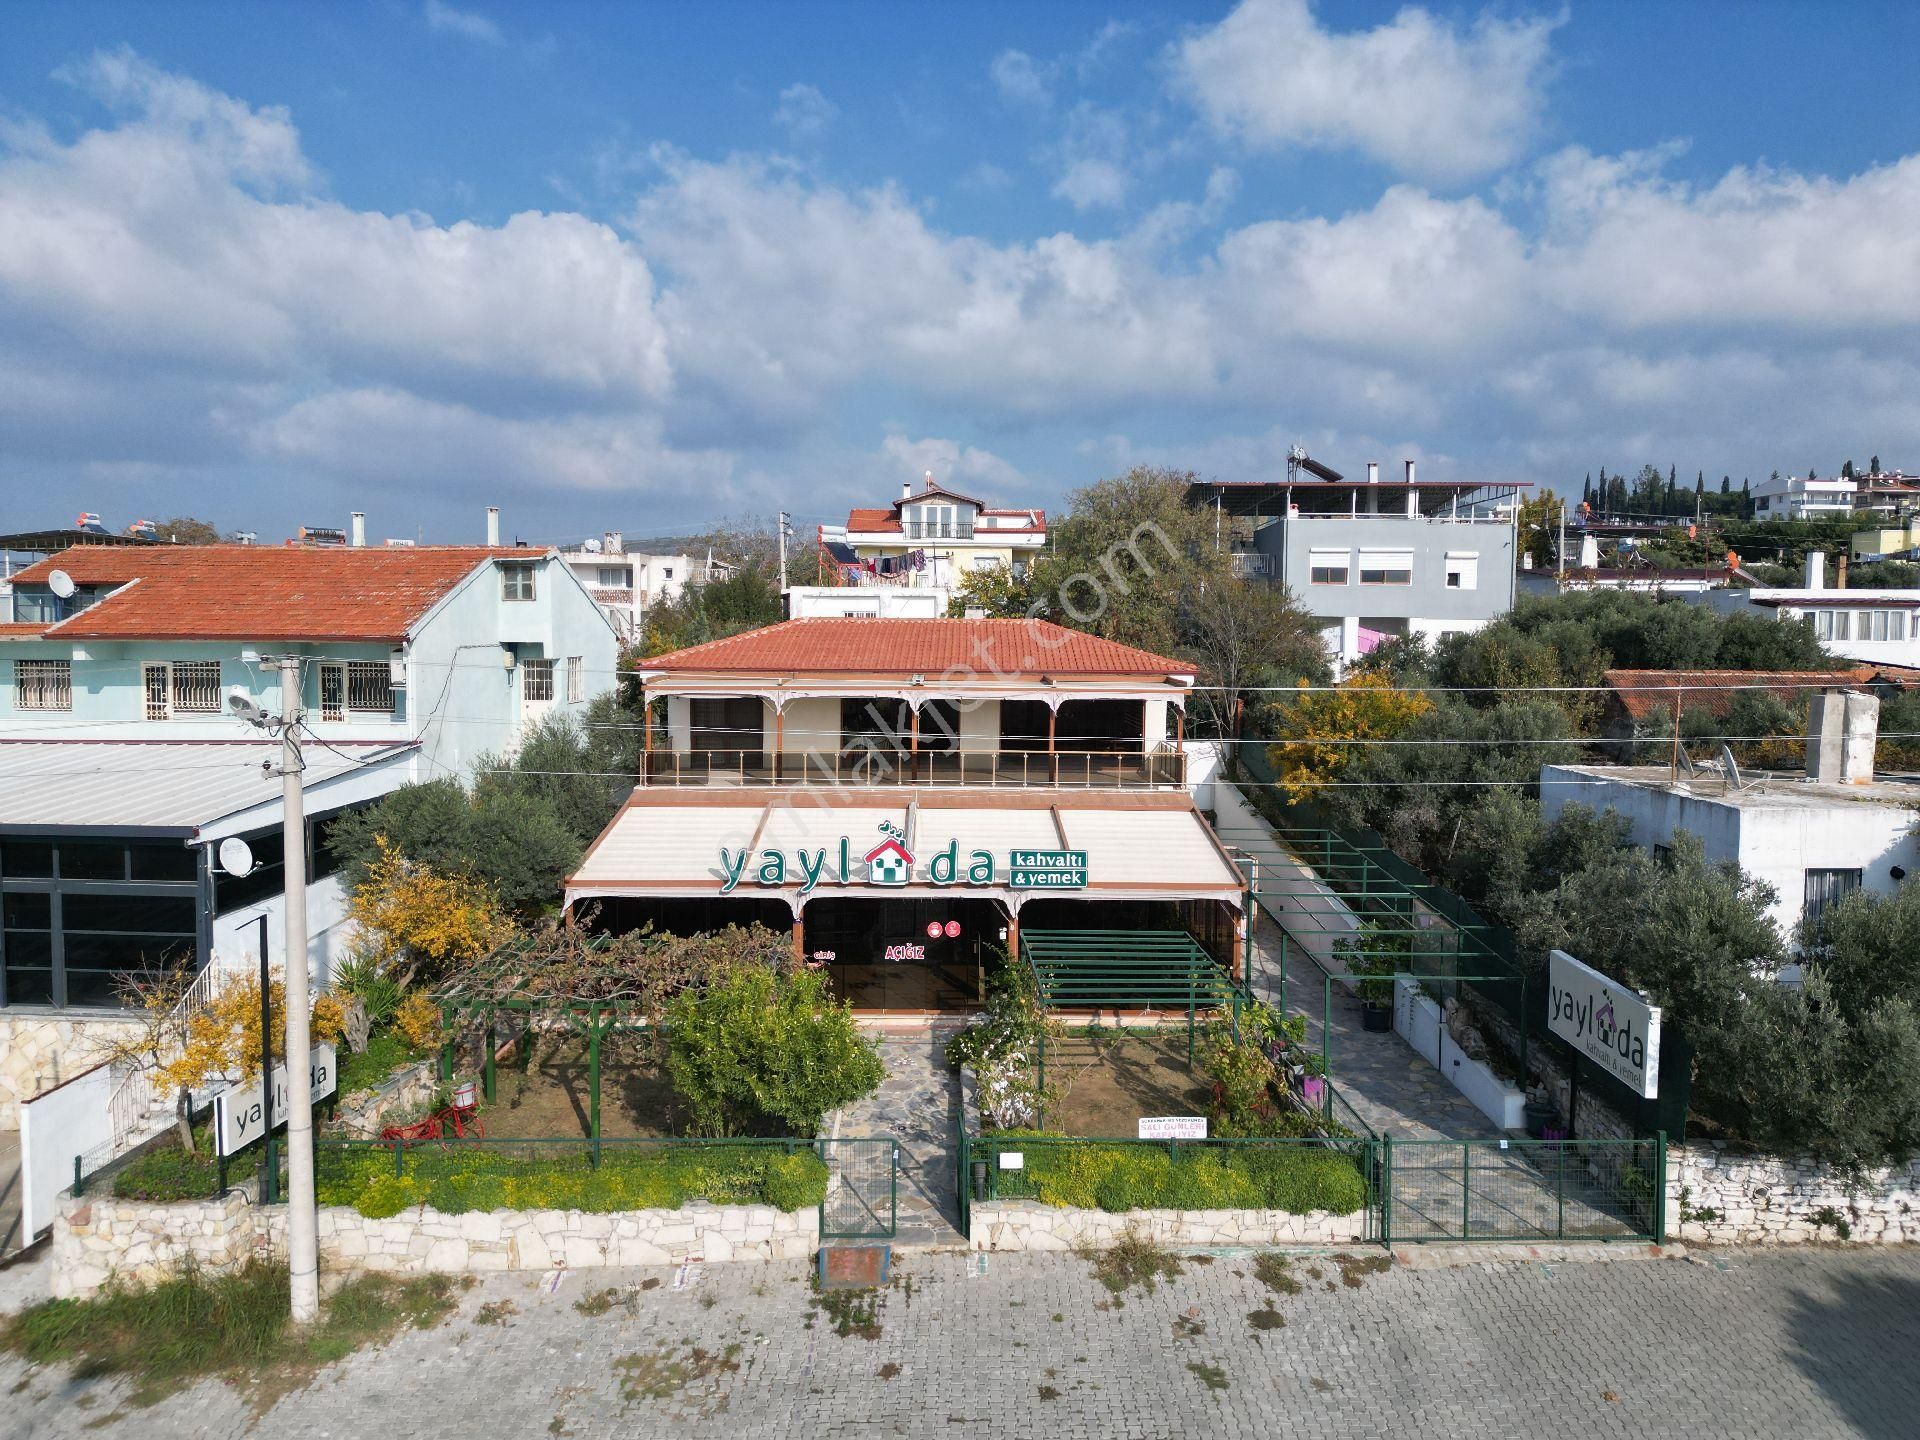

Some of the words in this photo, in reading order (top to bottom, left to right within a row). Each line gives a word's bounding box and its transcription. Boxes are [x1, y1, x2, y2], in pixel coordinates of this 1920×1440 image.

[1016, 851, 1083, 867] kahvaltı
[1015, 872, 1026, 884] &
[1029, 870, 1082, 886] yemek
[885, 942, 925, 962] AÇIĞIZ
